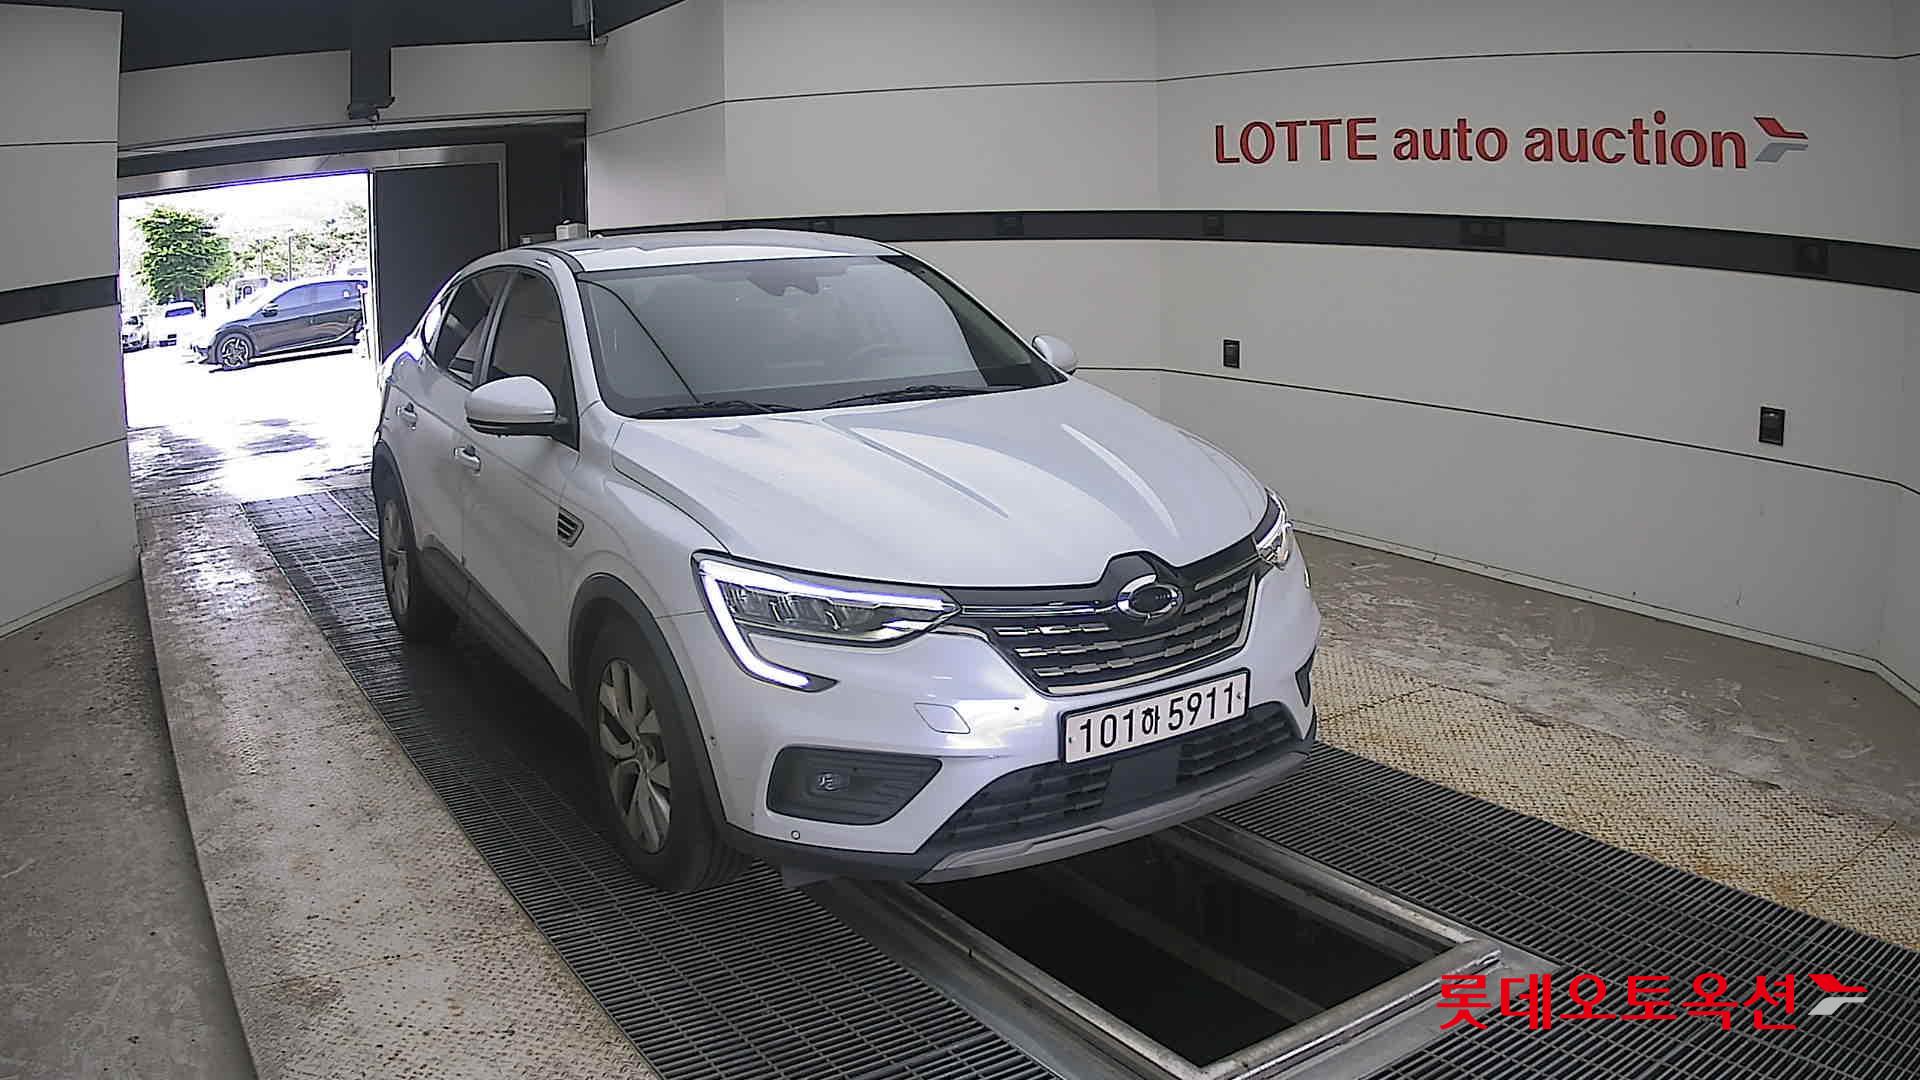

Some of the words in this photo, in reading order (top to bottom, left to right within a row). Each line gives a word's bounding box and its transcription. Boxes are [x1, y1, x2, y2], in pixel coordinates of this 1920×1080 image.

[1214, 117, 1377, 164] LOTTE
[1392, 117, 1507, 162] auto
[1523, 110, 1747, 169] auction
